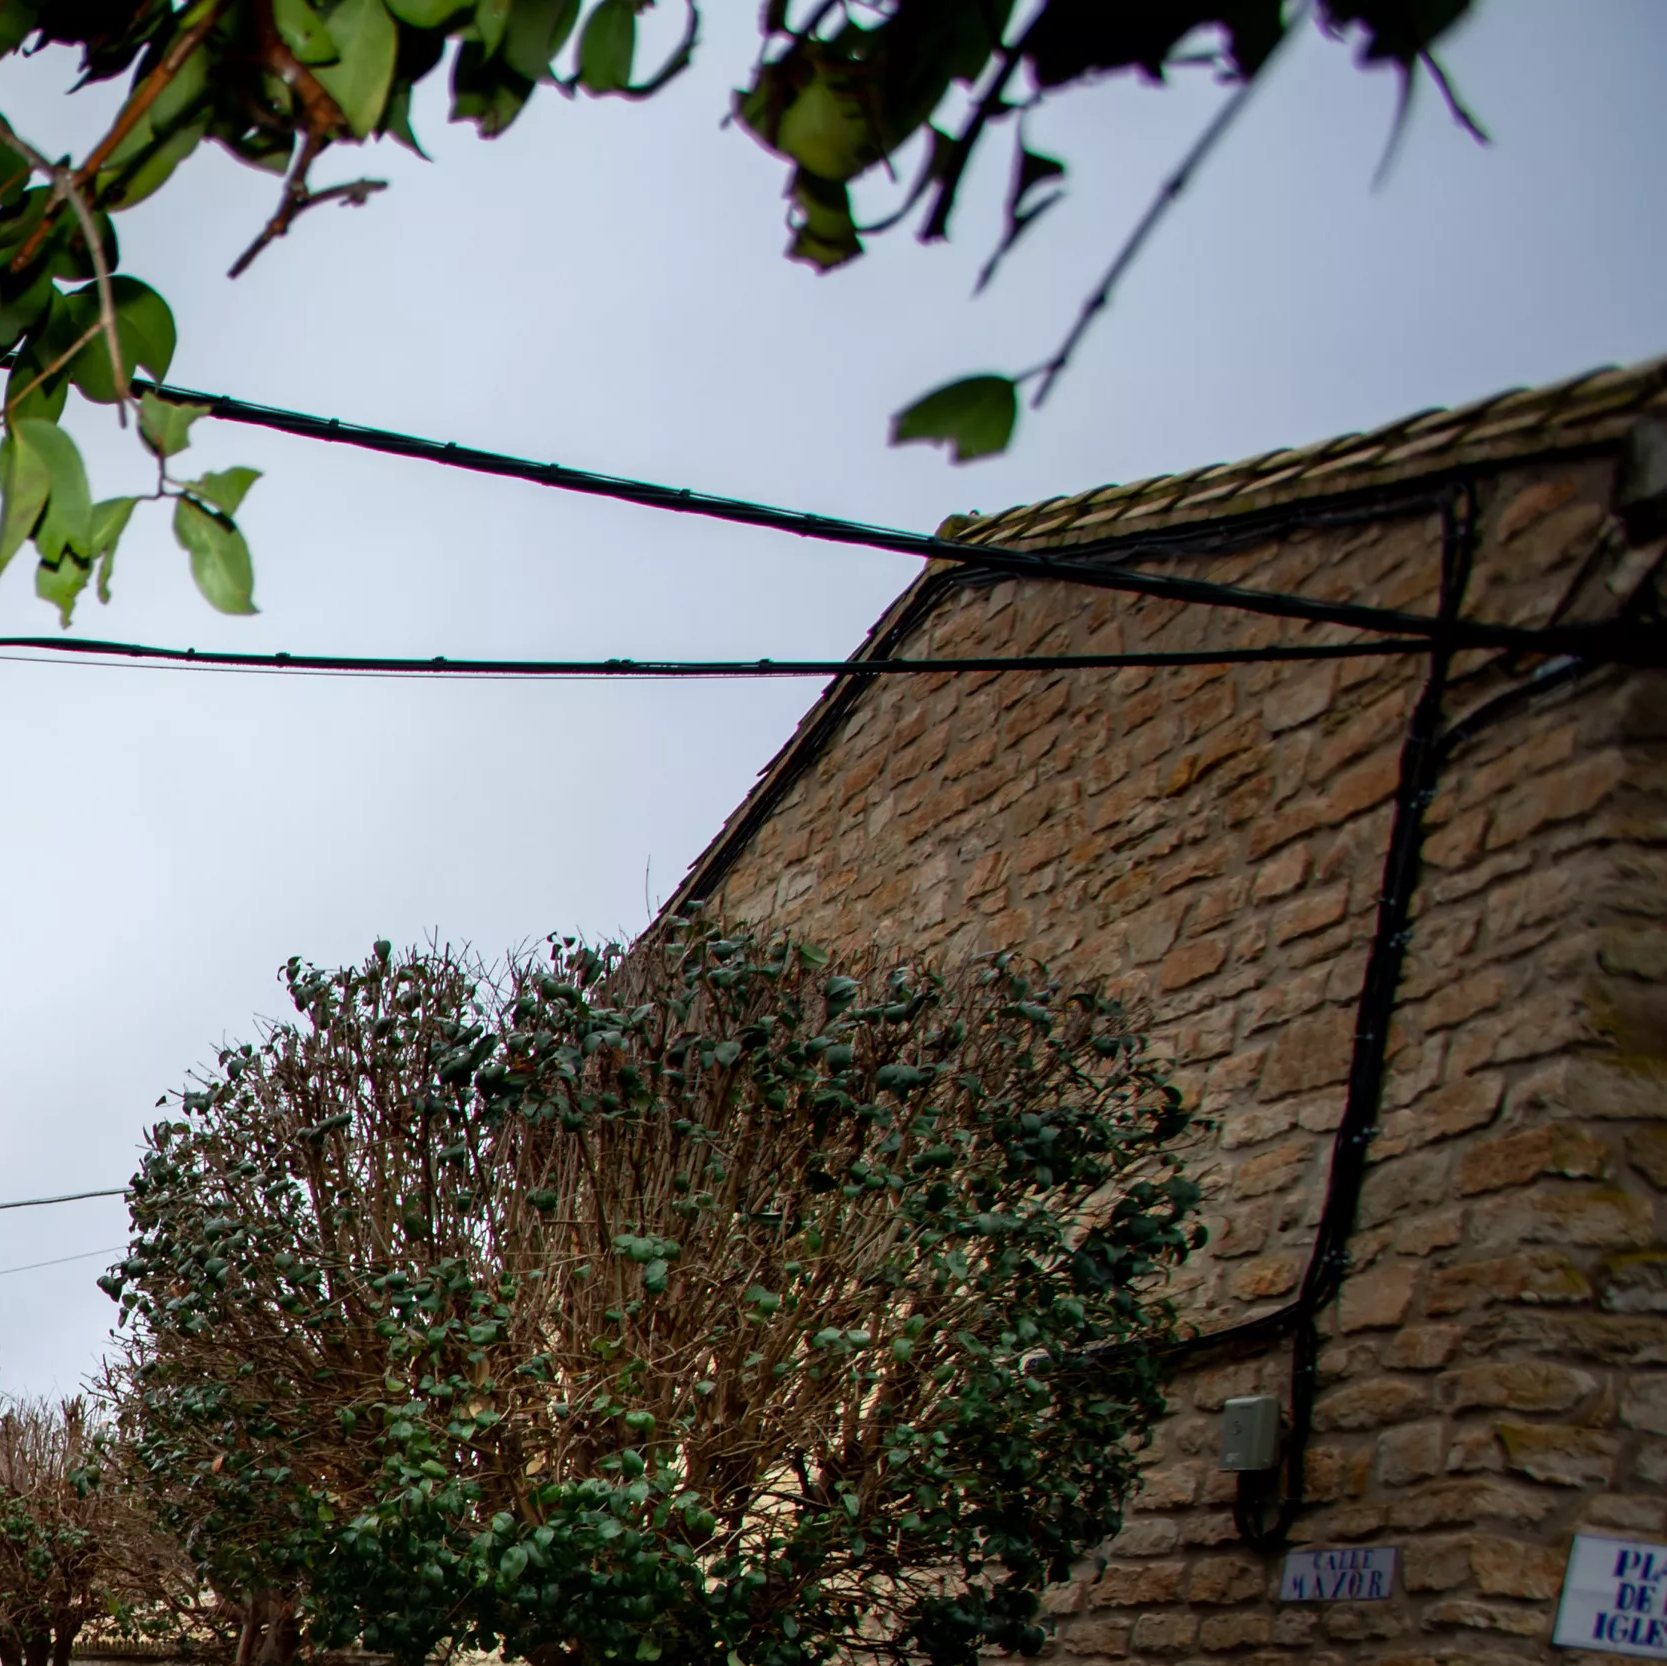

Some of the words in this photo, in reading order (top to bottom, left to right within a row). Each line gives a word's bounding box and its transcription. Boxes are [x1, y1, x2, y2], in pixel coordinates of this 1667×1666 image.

[1313, 1549, 1373, 1570] CALLE
[1615, 1582, 1657, 1614] DE
[1592, 1611, 1667, 1648] IGLE
